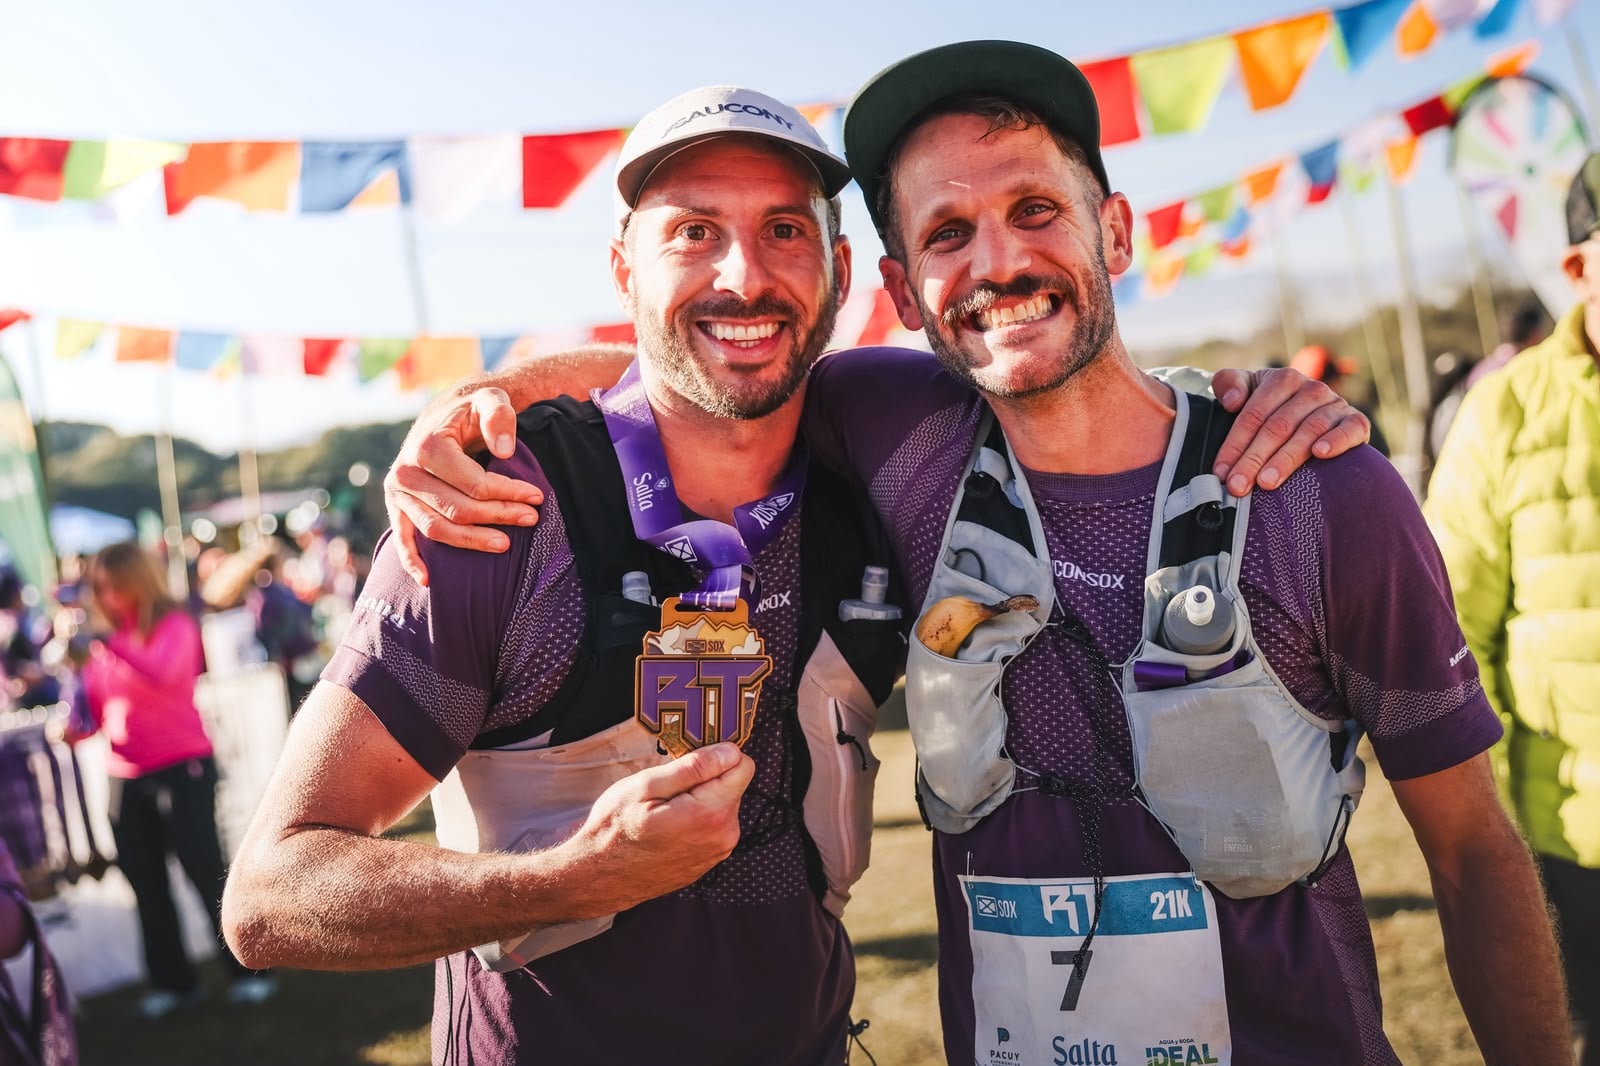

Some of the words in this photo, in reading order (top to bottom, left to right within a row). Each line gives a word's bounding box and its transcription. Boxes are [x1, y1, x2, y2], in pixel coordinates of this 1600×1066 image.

[660, 102, 794, 139] SAUCONY
[632, 472, 654, 512] Salta
[749, 504, 777, 530] SOX
[708, 640, 725, 653] SOX
[640, 659, 769, 743] RT
[998, 899, 1018, 919] SOX
[1150, 888, 1193, 921] 21K
[1050, 950, 1094, 1012] 7
[990, 1049, 1021, 1061] PACUY
[1052, 1035, 1118, 1066] Salta
[1145, 1043, 1219, 1066] IDEAL
[1158, 1038, 1175, 1046] AGUA
[1178, 1037, 1195, 1045] SODA
